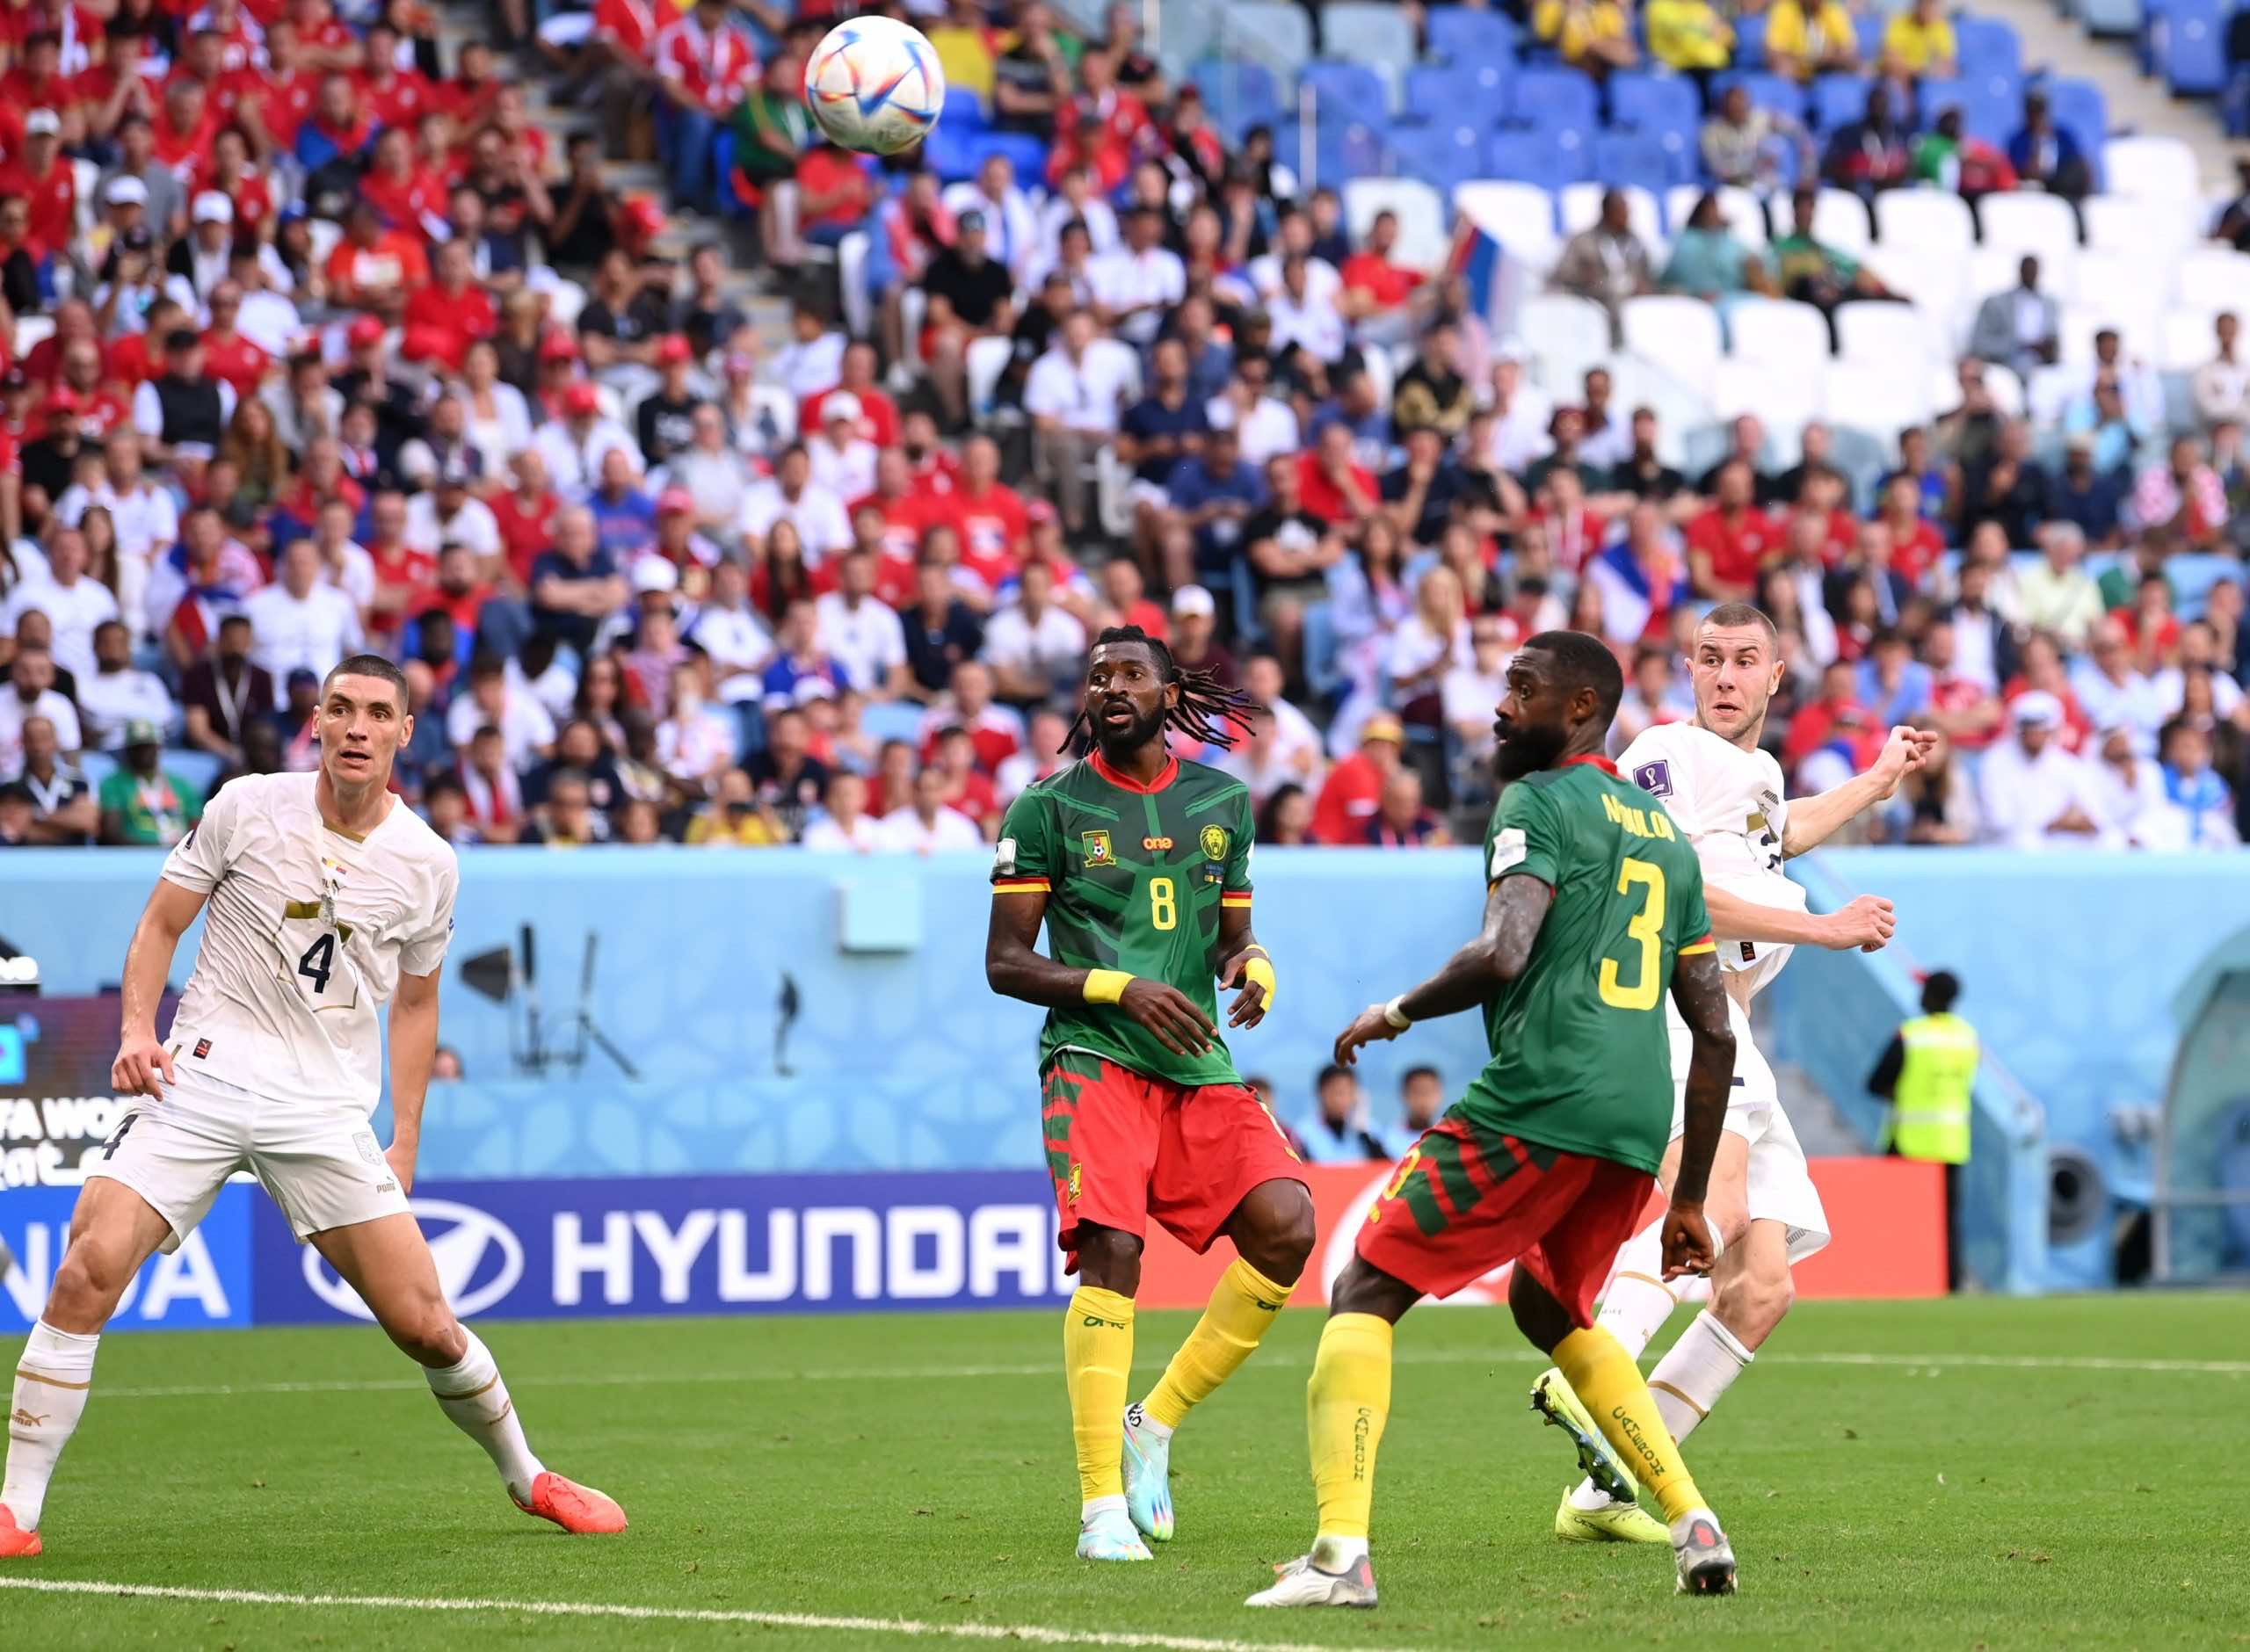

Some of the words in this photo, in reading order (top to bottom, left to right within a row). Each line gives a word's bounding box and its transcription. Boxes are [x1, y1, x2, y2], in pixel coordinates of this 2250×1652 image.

[1143, 837, 1173, 851] one
[1149, 876, 1177, 931] 8
[1598, 857, 1666, 1011] 3
[298, 933, 336, 995] 4
